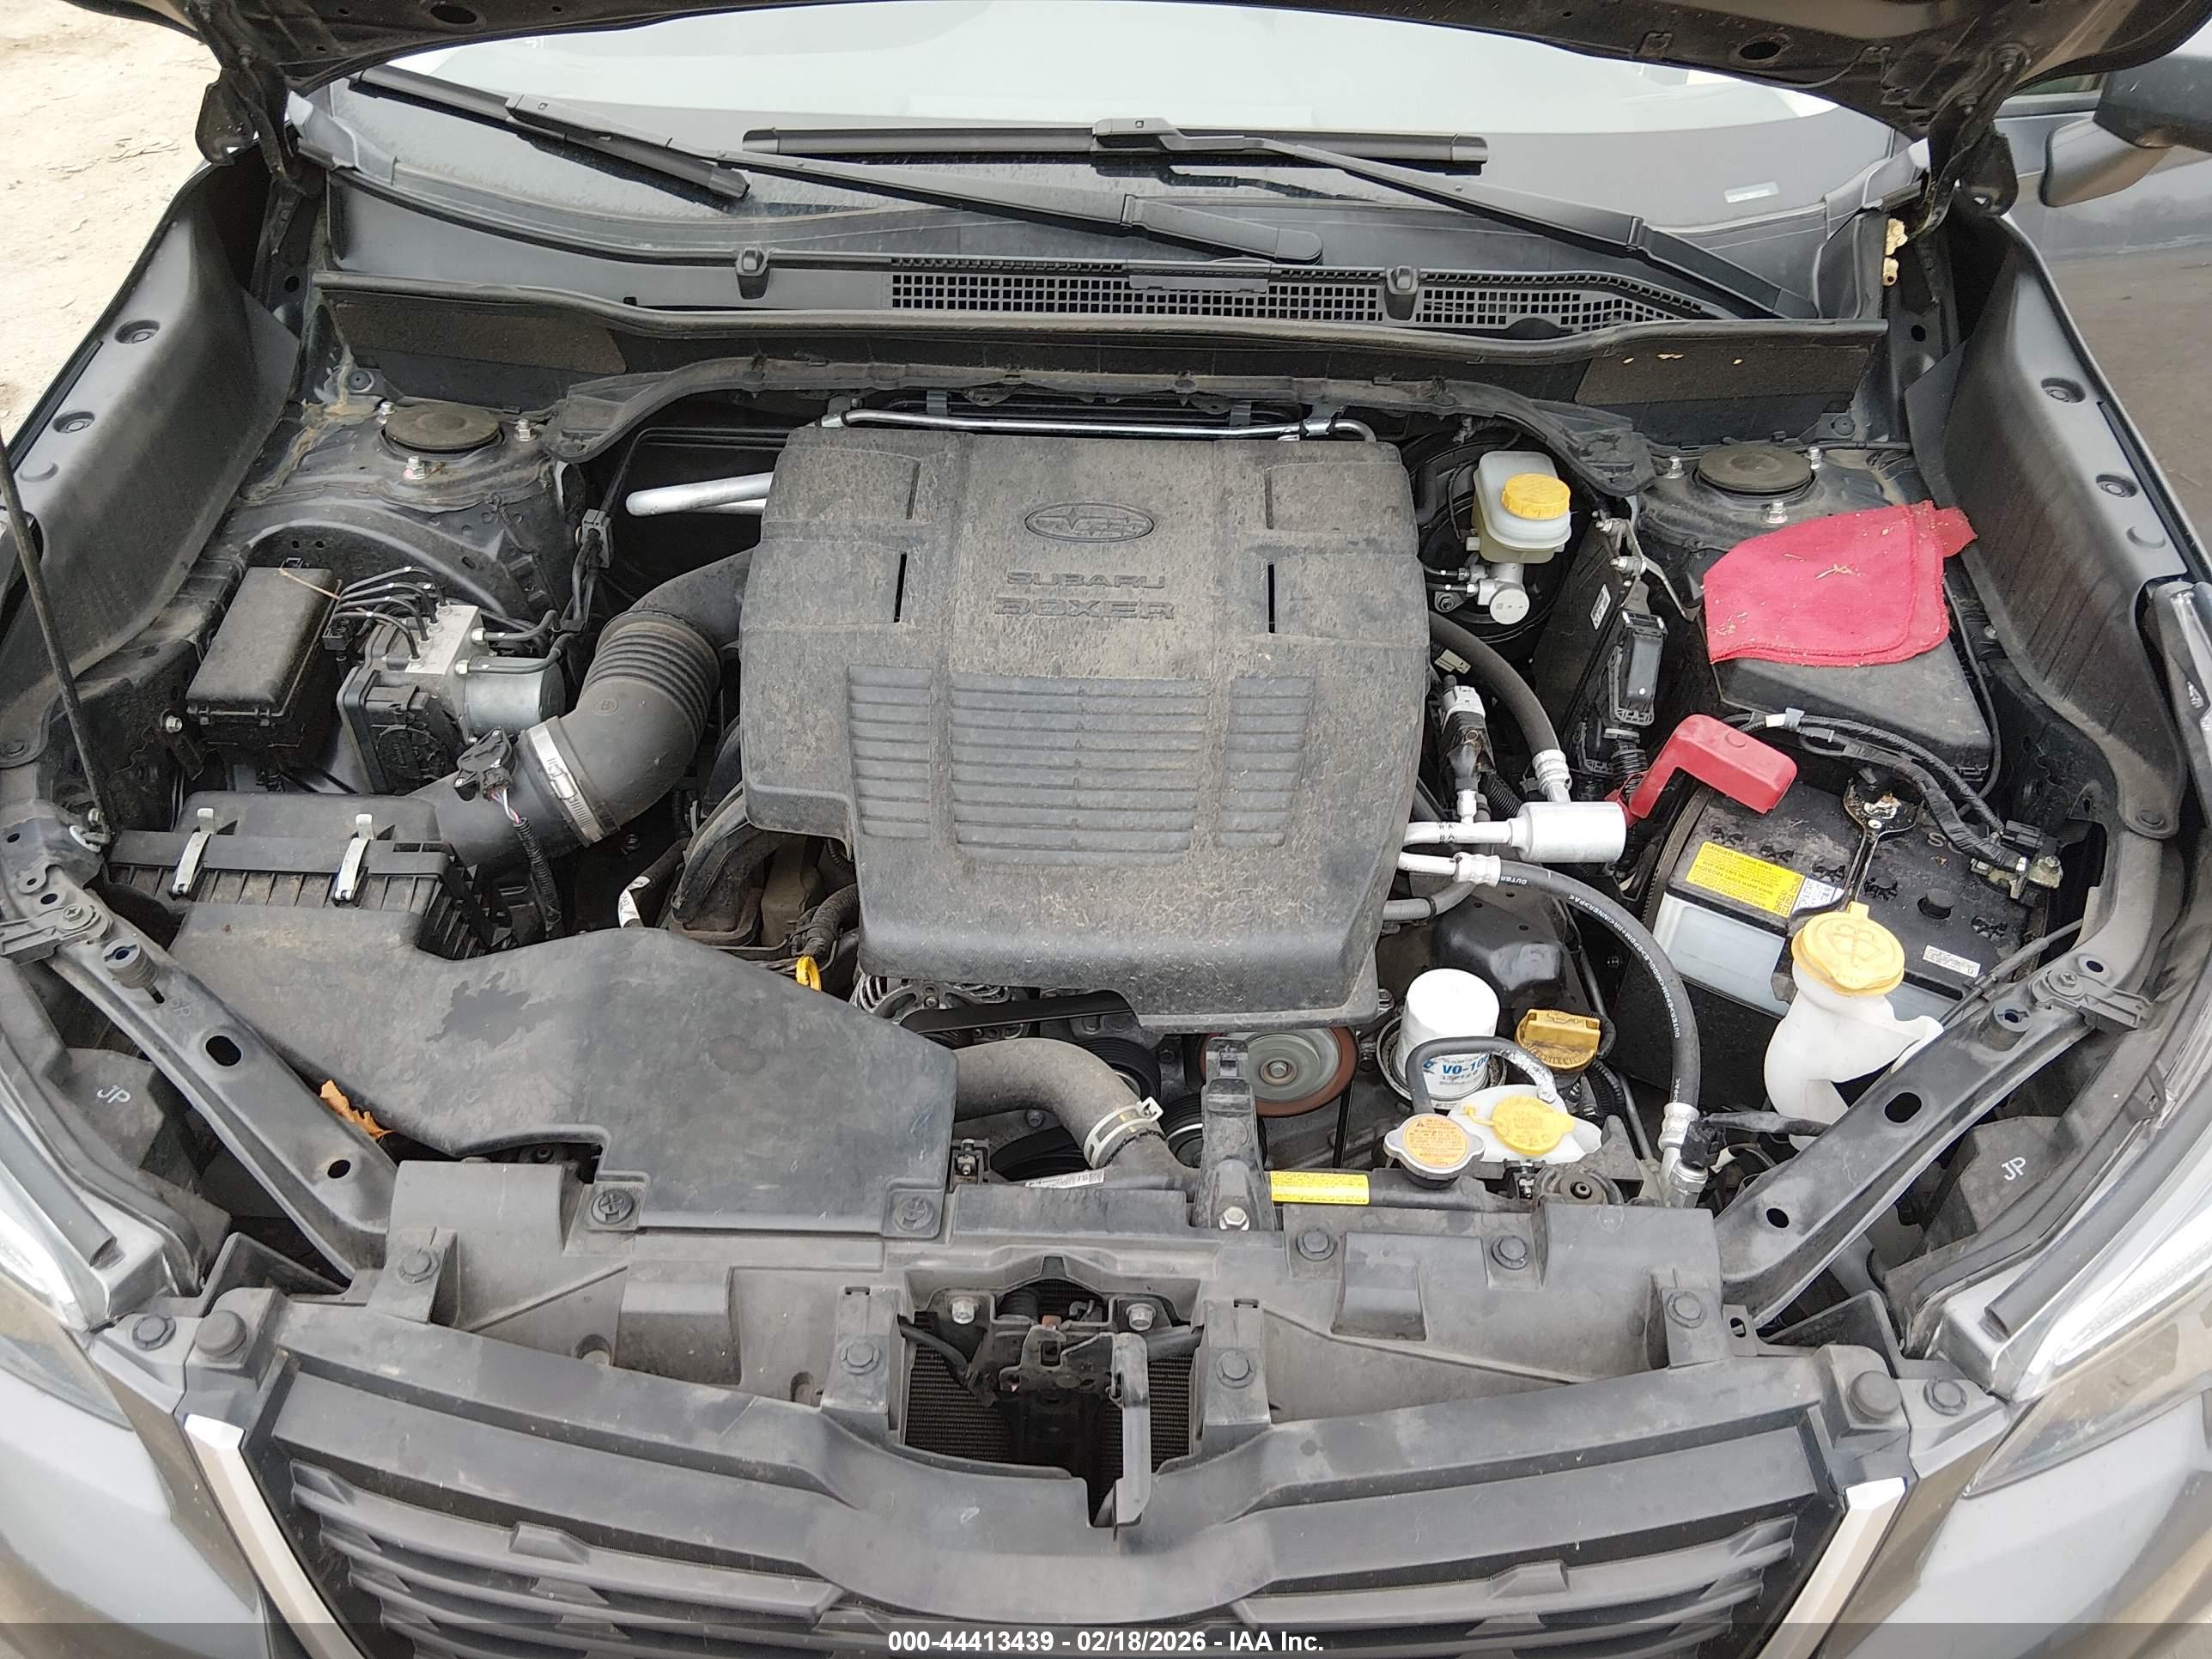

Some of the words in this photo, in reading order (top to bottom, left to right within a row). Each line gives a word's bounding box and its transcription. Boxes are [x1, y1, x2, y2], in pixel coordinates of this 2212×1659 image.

[1006, 571, 1165, 589] SUBARU
[994, 597, 1175, 619] BOXER
[96, 1085, 131, 1104] JP
[2001, 1156, 2027, 1182] JP
